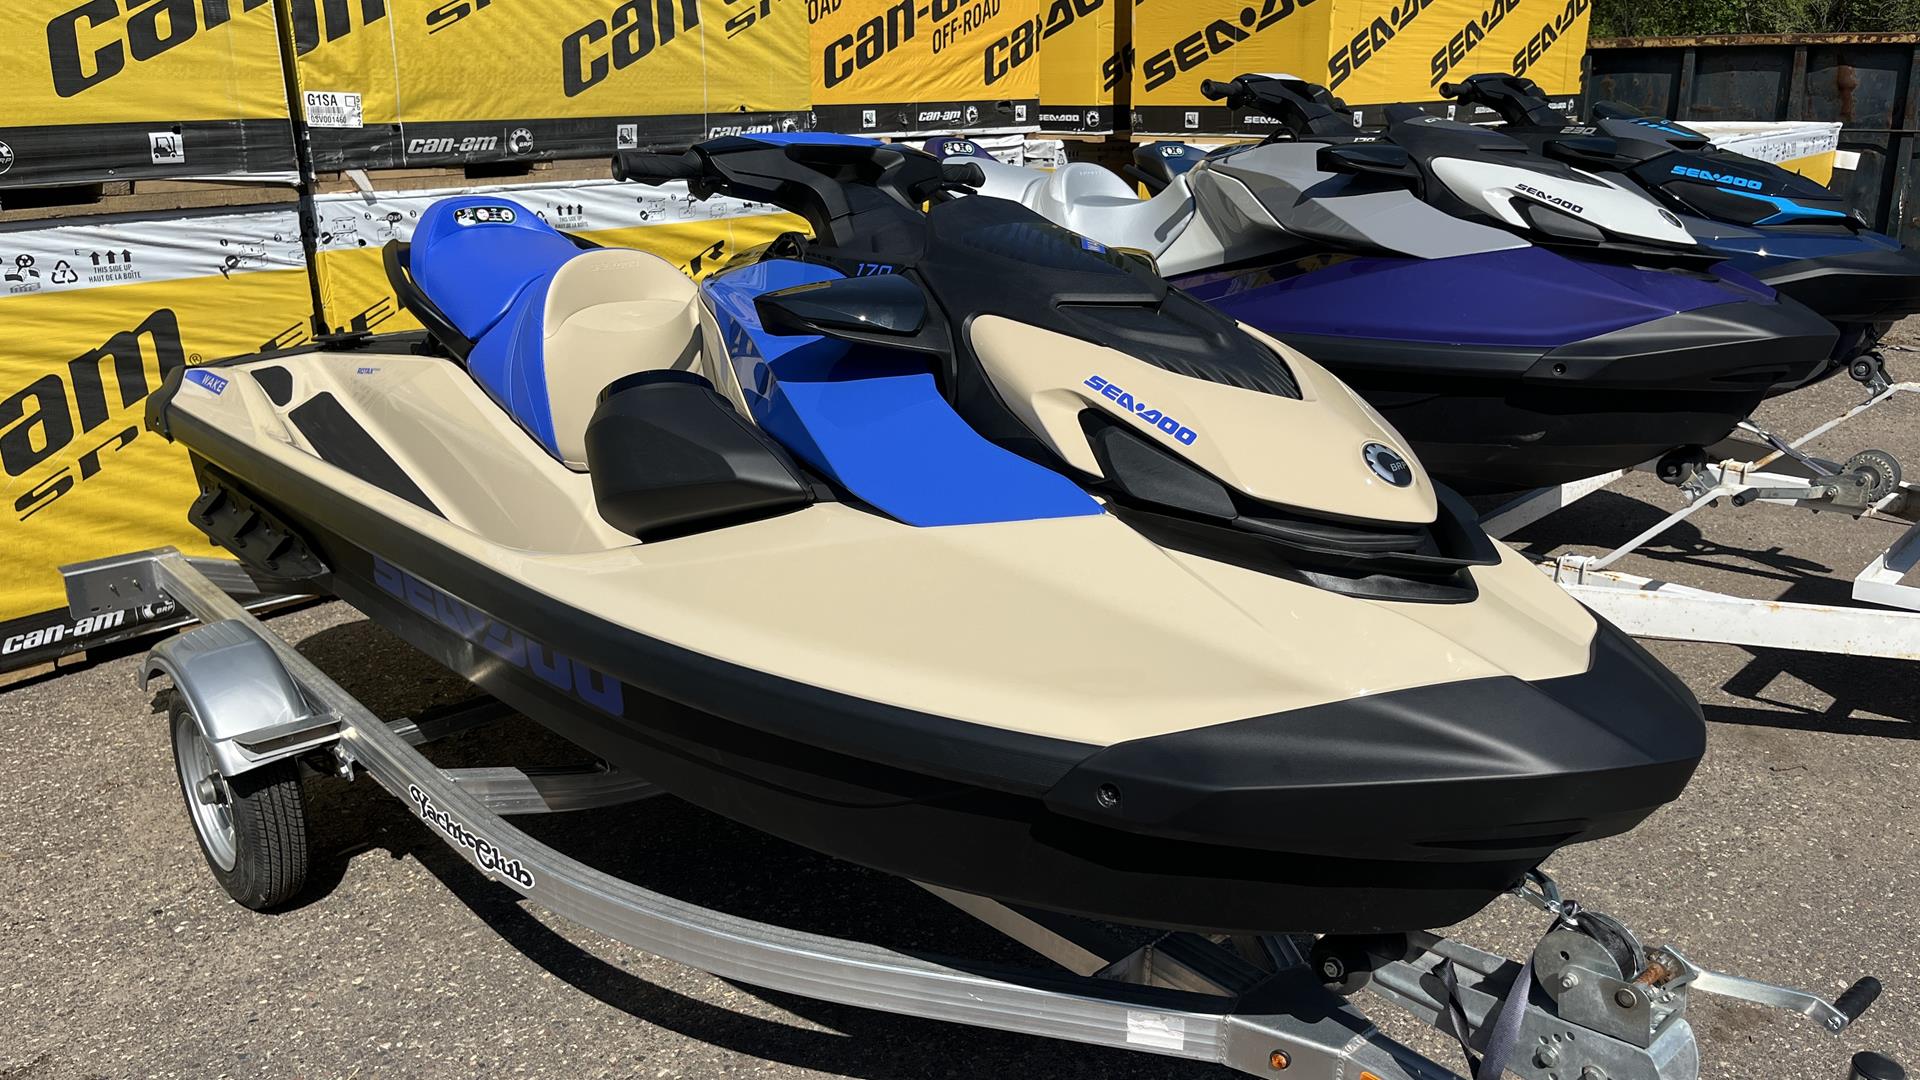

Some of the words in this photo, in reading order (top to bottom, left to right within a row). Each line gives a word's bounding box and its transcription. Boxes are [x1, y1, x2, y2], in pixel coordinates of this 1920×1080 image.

[307, 93, 338, 107] G1SA
[918, 110, 961, 122] can-am
[708, 124, 773, 139] can-am
[407, 136, 498, 154] can-am
[108, 265, 123, 273] SIDE
[856, 263, 893, 277] 170
[88, 275, 105, 283] HAUT
[201, 373, 226, 393] WAKE
[1390, 461, 1407, 472] BRP
[2, 609, 125, 655] can-am
